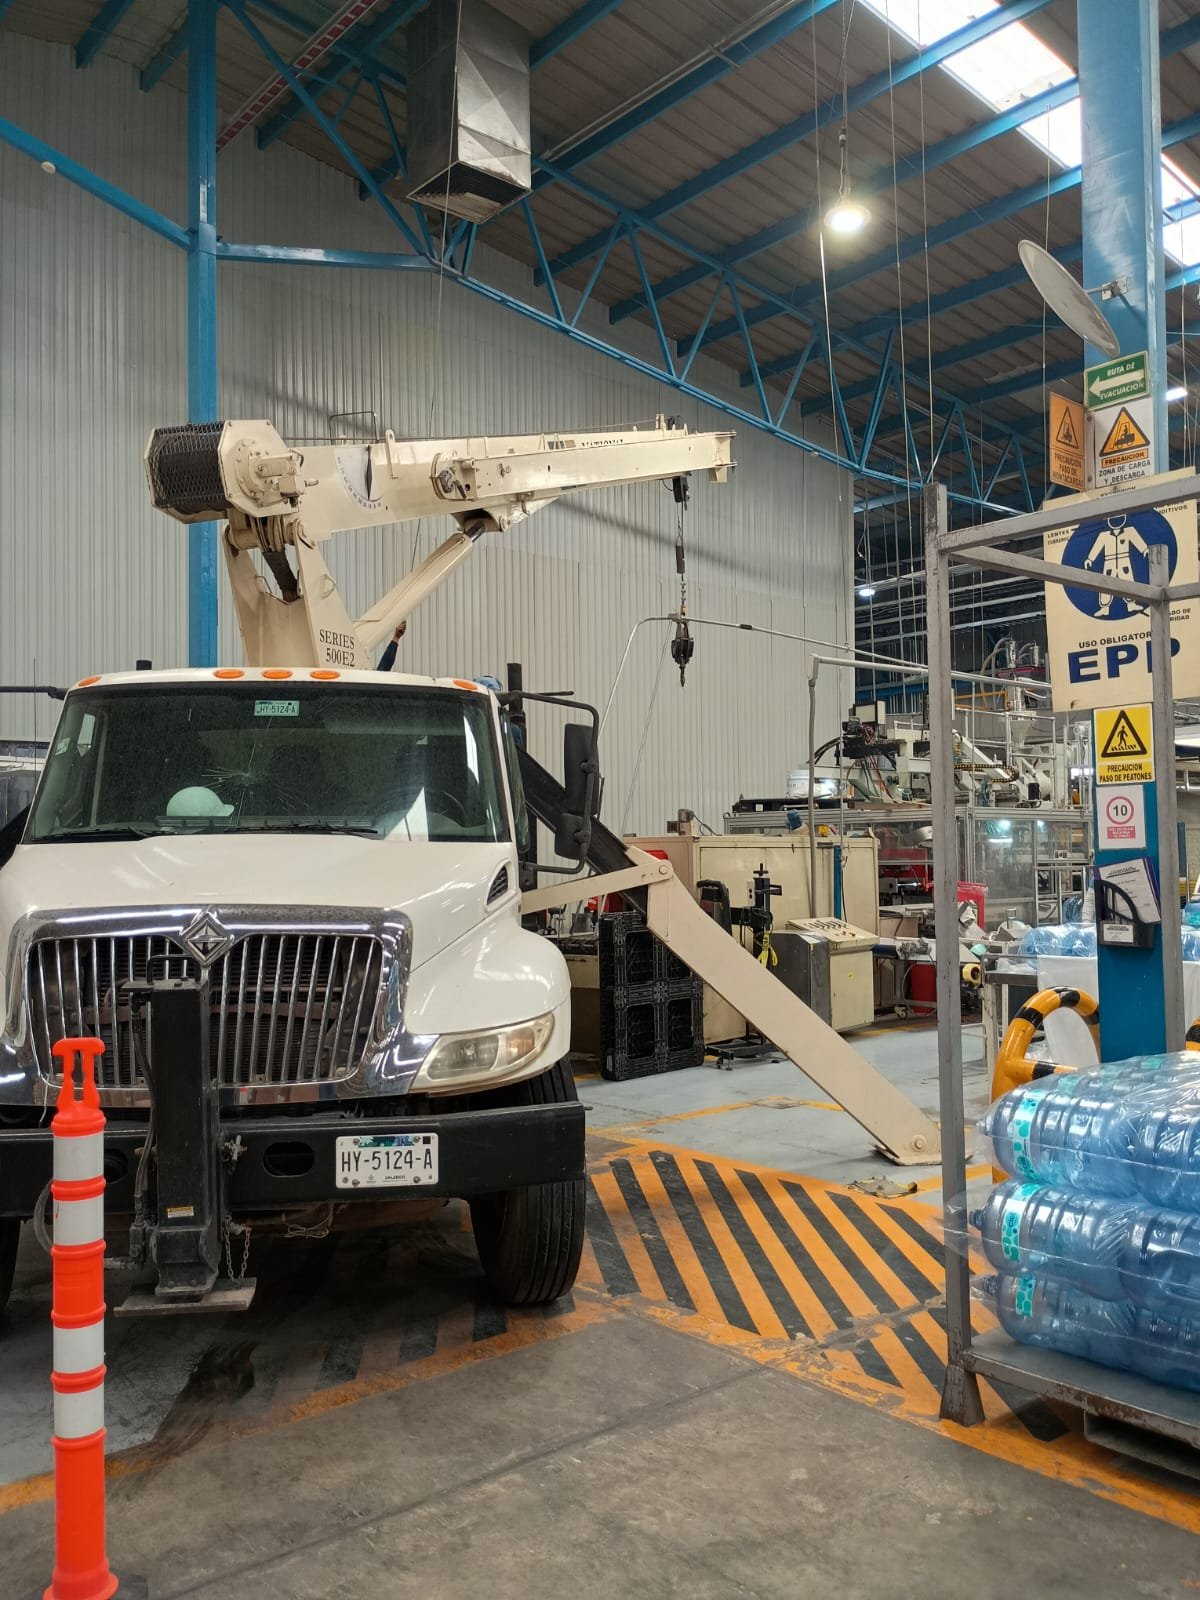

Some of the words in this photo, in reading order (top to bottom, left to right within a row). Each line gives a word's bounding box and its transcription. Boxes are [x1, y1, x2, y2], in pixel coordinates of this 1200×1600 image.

[1107, 365, 1125, 377] RUTA
[1126, 362, 1136, 371] DE
[1059, 463, 1070, 474] PASO
[1071, 467, 1077, 476] DE
[1099, 467, 1116, 477] ZONA
[1128, 459, 1151, 470] CARGA
[1111, 470, 1146, 483] DESCARGA
[1047, 529, 1070, 539] LENTES
[319, 629, 355, 650] SERIES
[1078, 640, 1097, 649] USO
[1100, 631, 1152, 646] OBLIGATOR
[326, 647, 355, 667] 500E2
[1114, 774, 1122, 782] DE
[1123, 772, 1152, 781] PEATONES
[1113, 804, 1128, 817] 10
[341, 1148, 433, 1173] HY-5124-A
